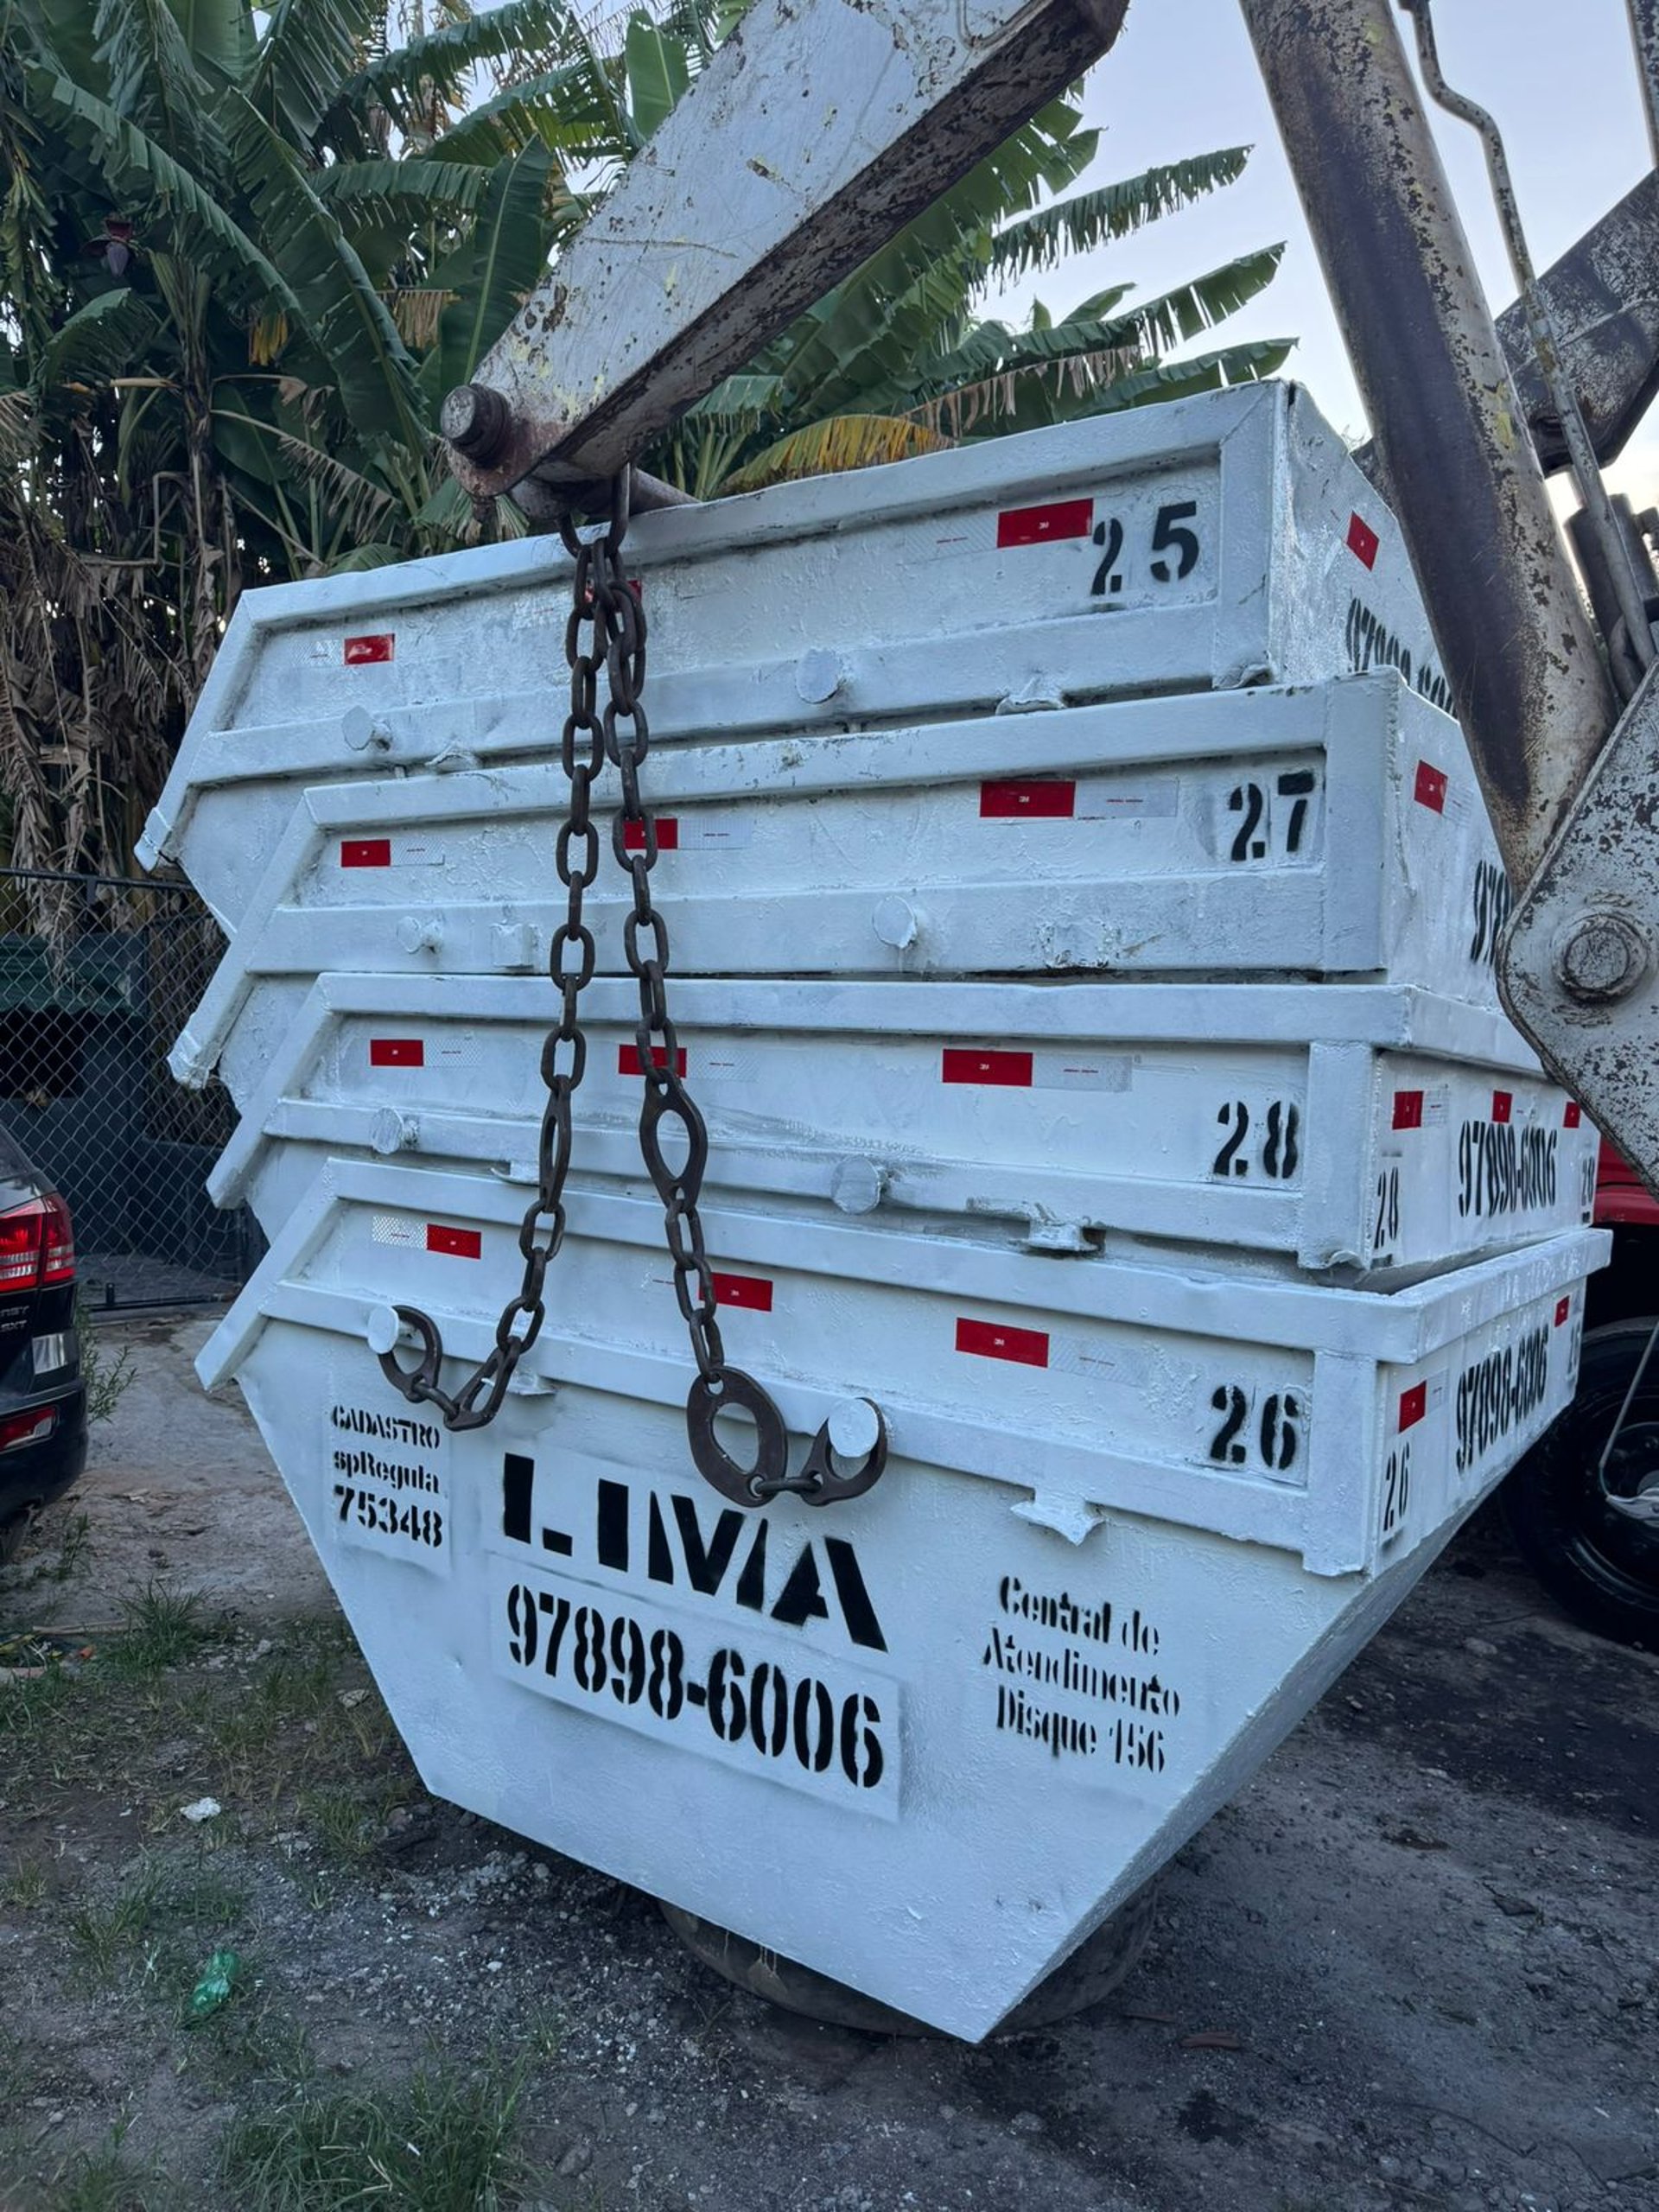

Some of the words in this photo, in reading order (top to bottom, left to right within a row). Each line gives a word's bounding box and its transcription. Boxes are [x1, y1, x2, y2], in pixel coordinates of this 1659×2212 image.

[1091, 500, 1199, 596] 25
[1229, 770, 1315, 861] 27
[1213, 1100, 1299, 1179] 28
[1459, 1120, 1557, 1217] 97898-6006
[1374, 1166, 1399, 1249] 28
[332, 1405, 440, 1449] CADASTRO
[1210, 1384, 1298, 1471] 26
[1456, 1324, 1548, 1474] 97898-6006
[334, 1451, 439, 1494] spRegula
[334, 1484, 442, 1548] 75348
[1383, 1440, 1410, 1532] 26
[504, 1452, 889, 1654] LIMA
[1000, 1575, 1111, 1643] Central
[1122, 1609, 1160, 1656] de
[507, 1584, 885, 1789] 97898-6006
[983, 1626, 1179, 1718] Atendimento
[997, 1684, 1096, 1758] Disque
[1109, 1718, 1165, 1773] 156
